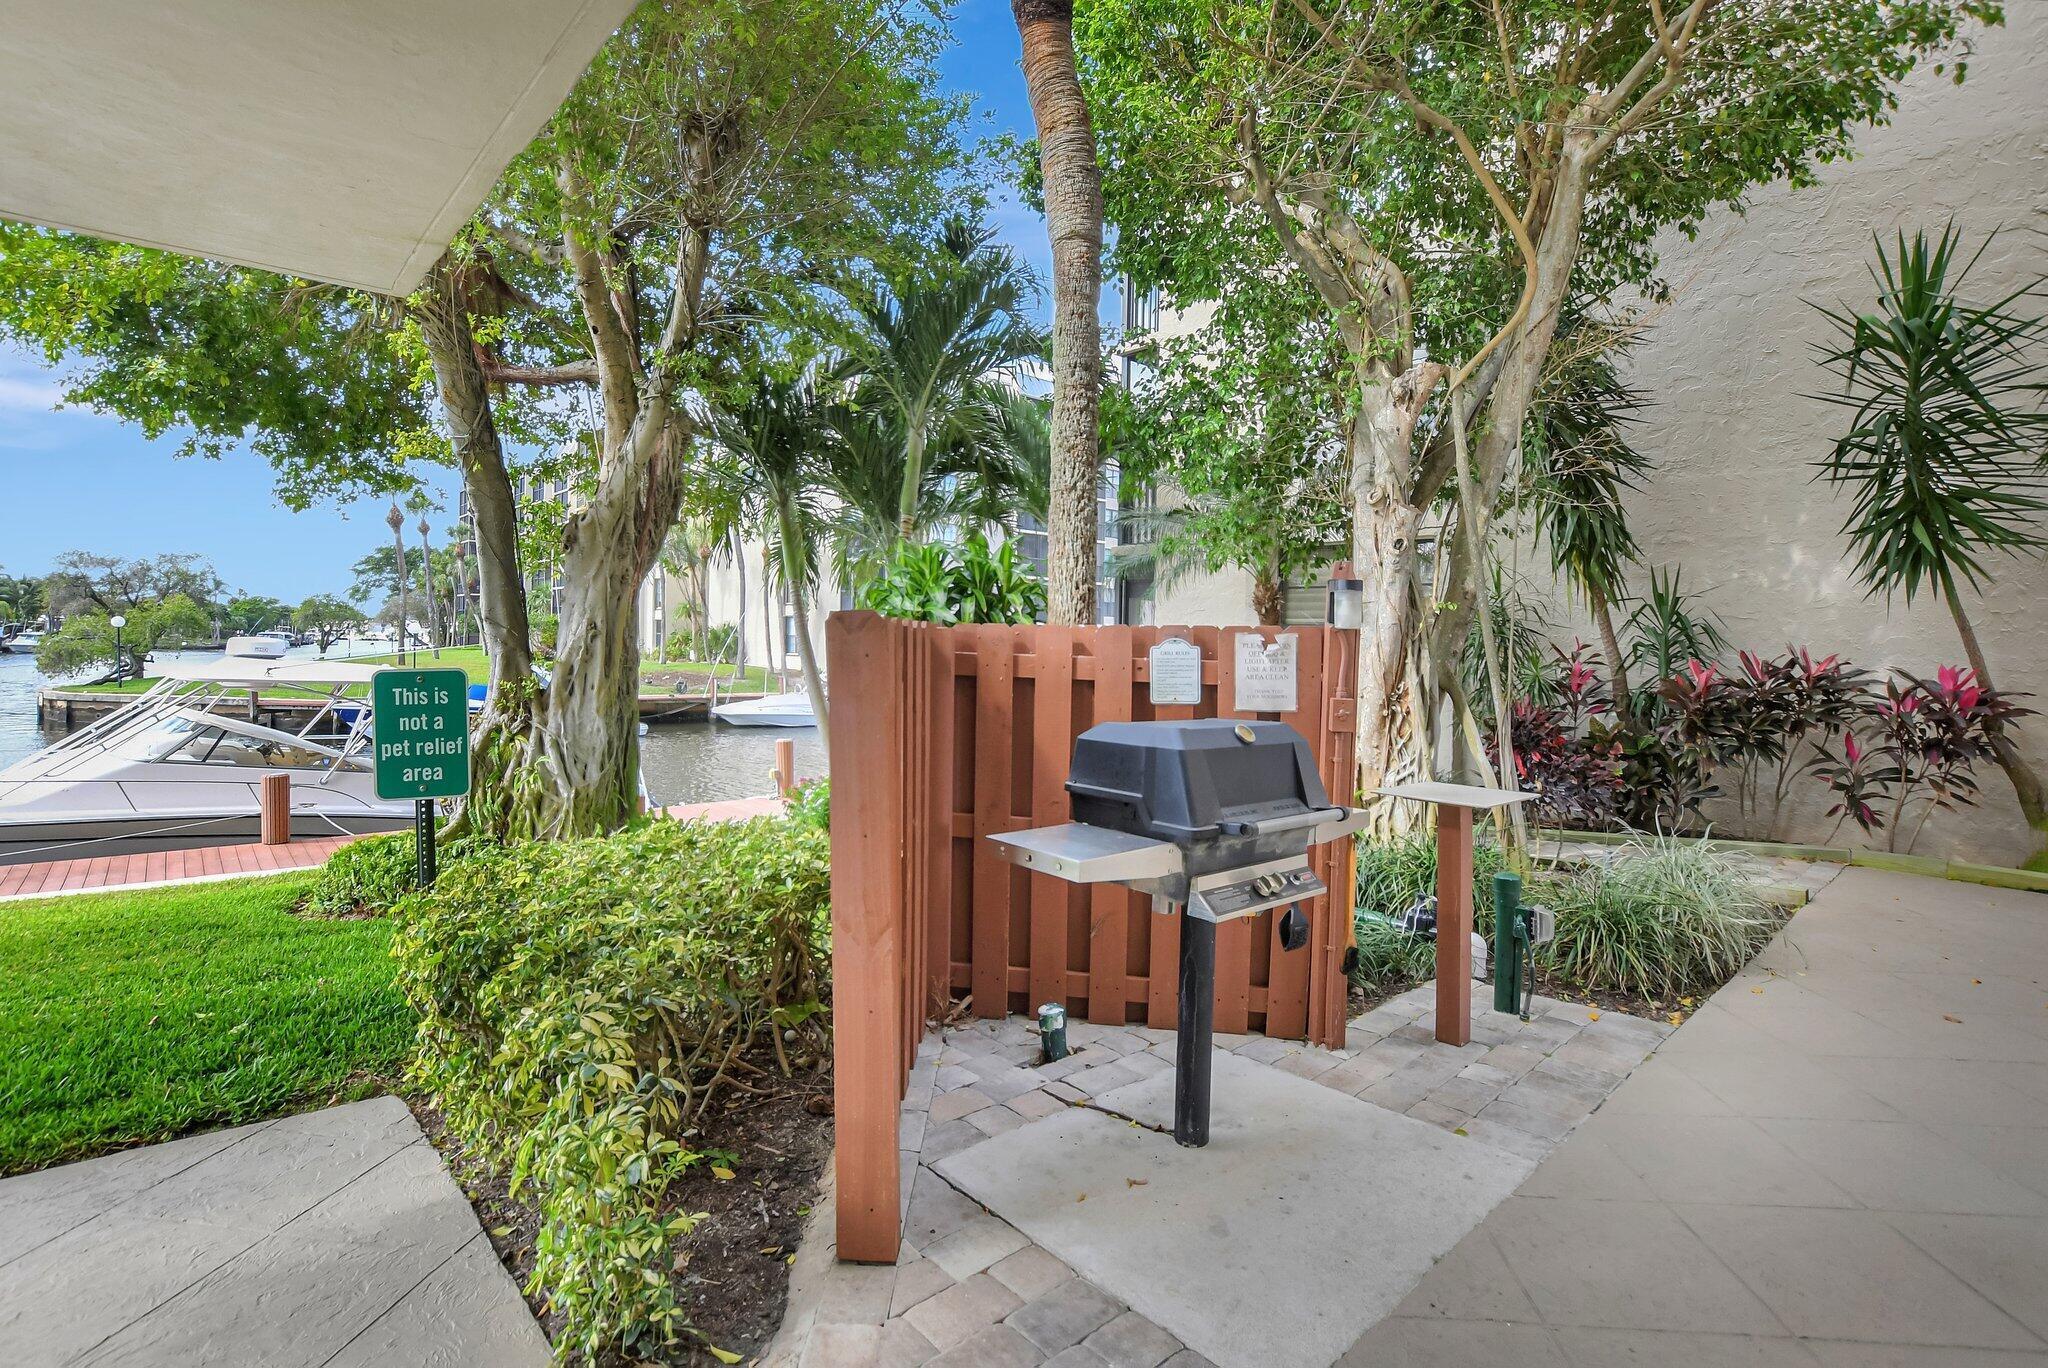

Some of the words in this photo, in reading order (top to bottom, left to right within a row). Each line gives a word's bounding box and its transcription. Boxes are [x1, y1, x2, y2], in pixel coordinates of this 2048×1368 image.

[392, 687, 428, 705] This
[434, 687, 449, 704] is
[400, 714, 428, 730] not
[433, 716, 444, 730] a
[381, 739, 410, 761] pet
[416, 736, 463, 755] relief
[403, 766, 443, 781] area
